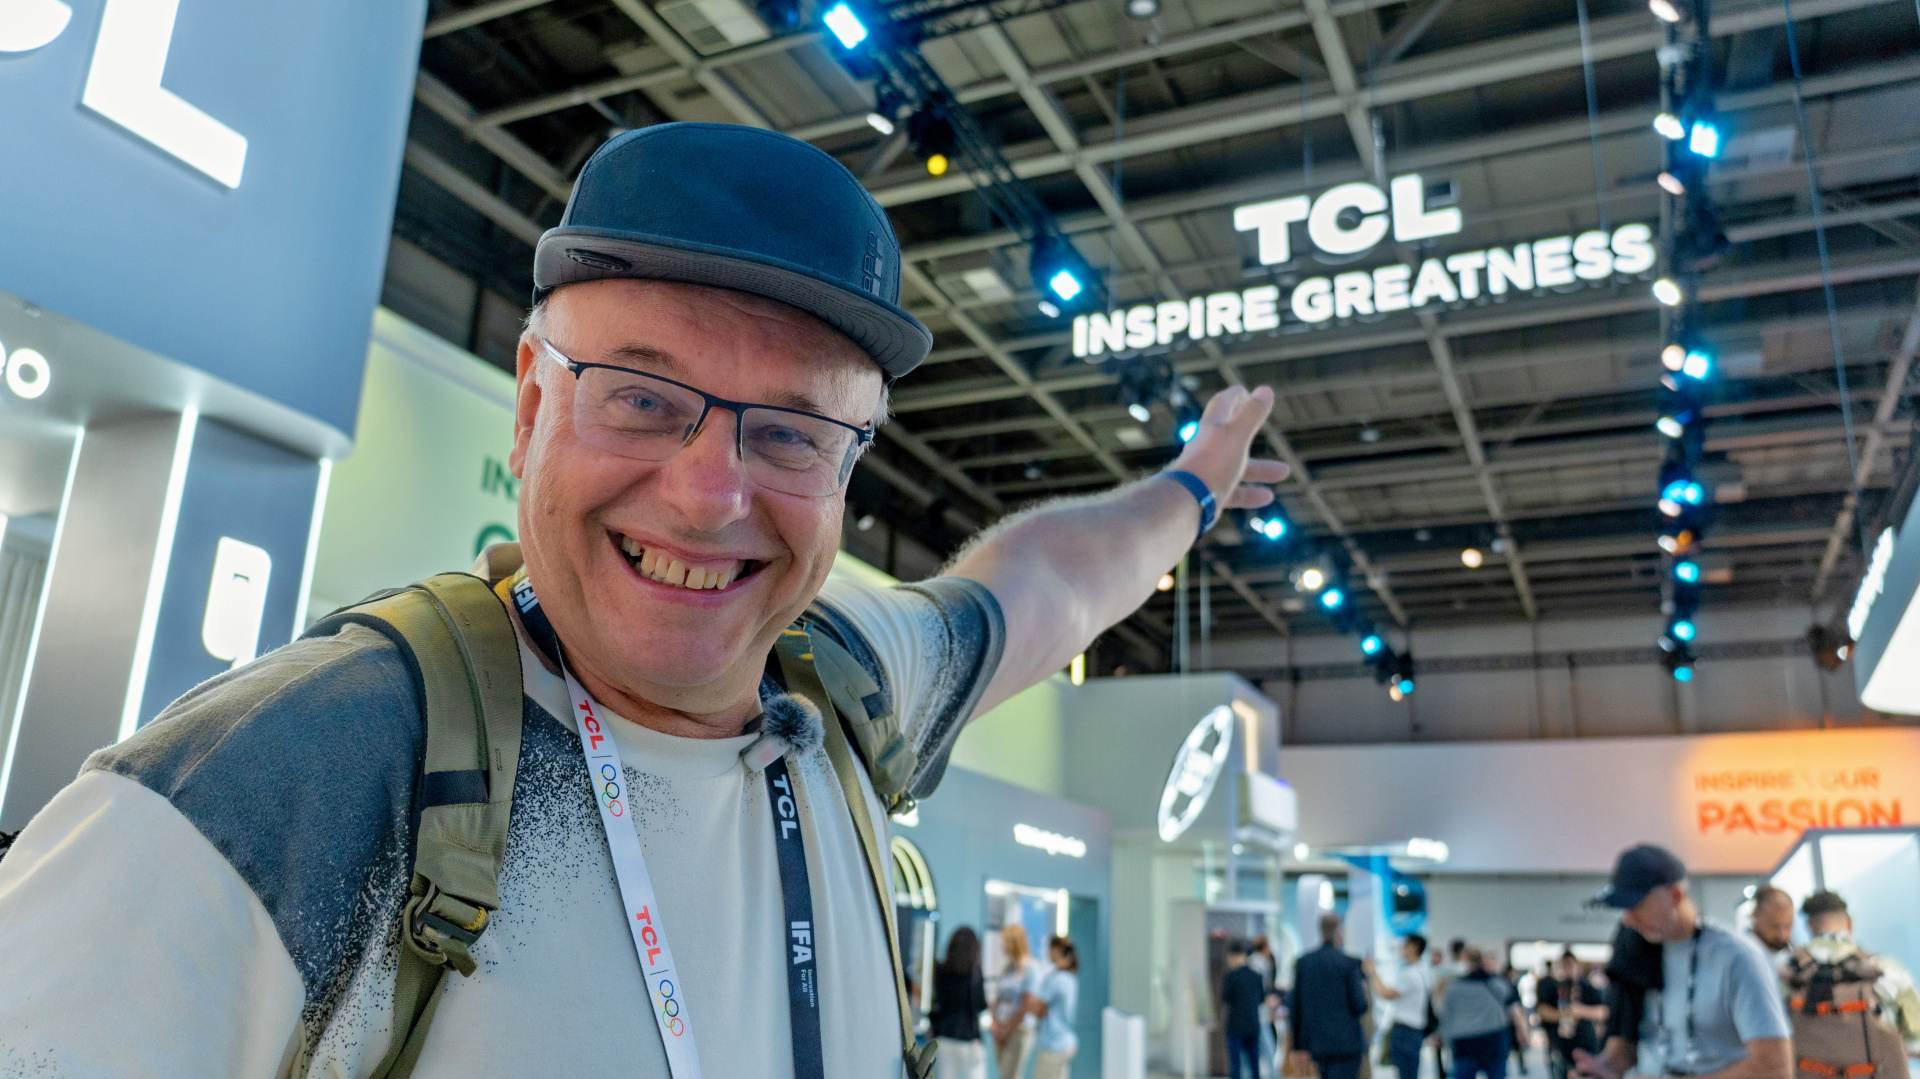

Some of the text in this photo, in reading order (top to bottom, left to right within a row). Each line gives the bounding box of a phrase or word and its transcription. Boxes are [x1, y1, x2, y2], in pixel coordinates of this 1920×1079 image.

[1233, 173, 1463, 266] TCL
[1072, 222, 1656, 358] INSPIRE GREATNESS
[579, 699, 605, 751] TCL
[772, 773, 798, 840] TCL
[1695, 769, 1794, 791] INSPIRE
[1696, 797, 1902, 835] PASSION
[635, 905, 663, 967] TCL
[791, 920, 812, 965] IFA
